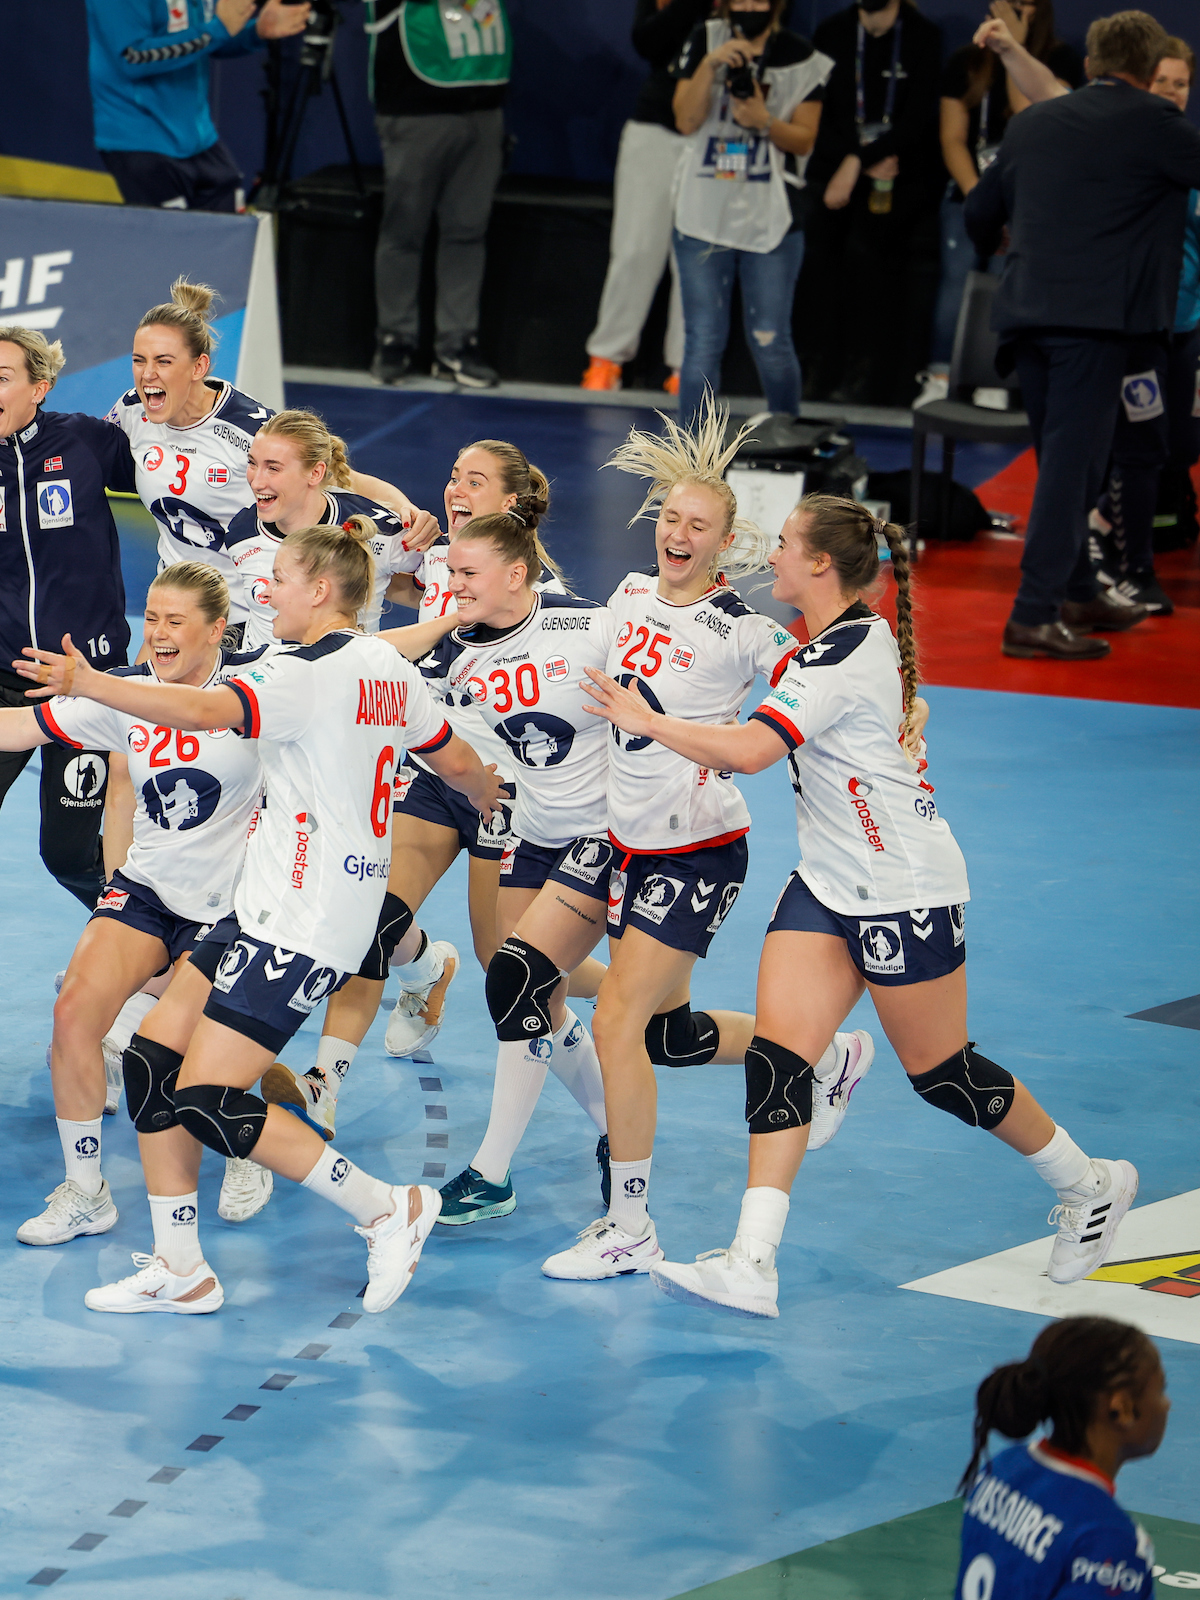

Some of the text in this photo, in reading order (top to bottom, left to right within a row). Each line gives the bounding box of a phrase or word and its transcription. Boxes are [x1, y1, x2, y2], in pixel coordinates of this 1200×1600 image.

[168, 454, 190, 496] 3
[41, 516, 72, 526] Gjensidige
[237, 547, 263, 565] posten
[541, 616, 592, 631] GJENSIDIGE
[651, 618, 671, 632] hummel
[87, 634, 111, 658] 16
[502, 651, 530, 665] hummel
[621, 626, 672, 678] 25
[455, 658, 478, 685] posten
[488, 663, 540, 713] 30
[149, 725, 200, 768] 26
[60, 796, 102, 809] Gjensidige
[370, 745, 394, 838] 6
[850, 798, 885, 852] posten
[291, 831, 309, 889] posten
[561, 861, 596, 882] Gjensidige
[864, 961, 904, 972] Gjensidige
